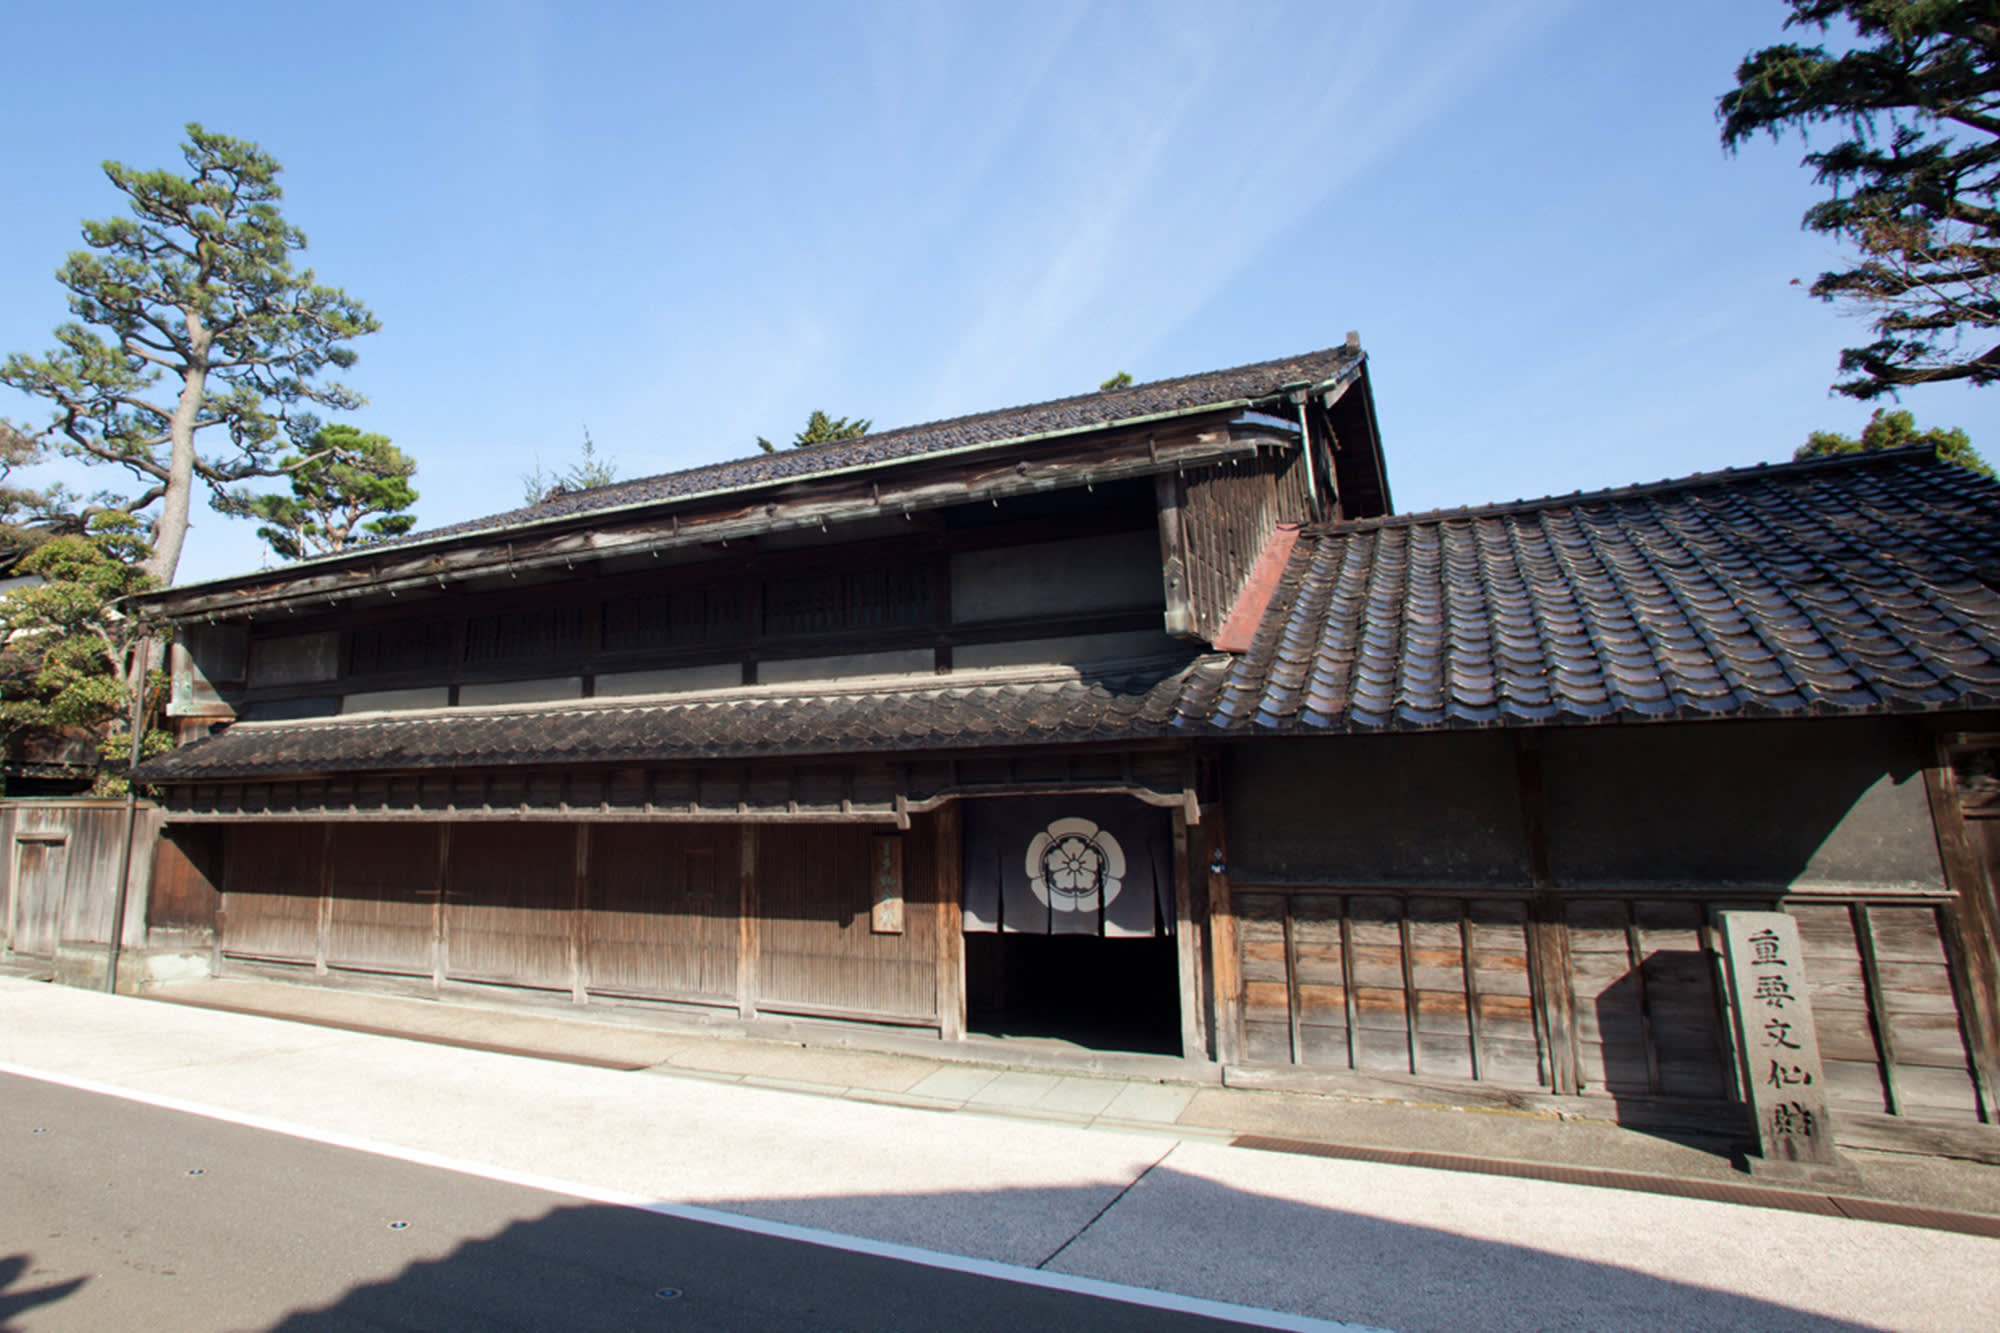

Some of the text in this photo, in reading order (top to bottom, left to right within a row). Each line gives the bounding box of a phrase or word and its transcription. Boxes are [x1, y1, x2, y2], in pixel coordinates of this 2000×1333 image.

[1748, 929, 1812, 1136] 重要文化財
